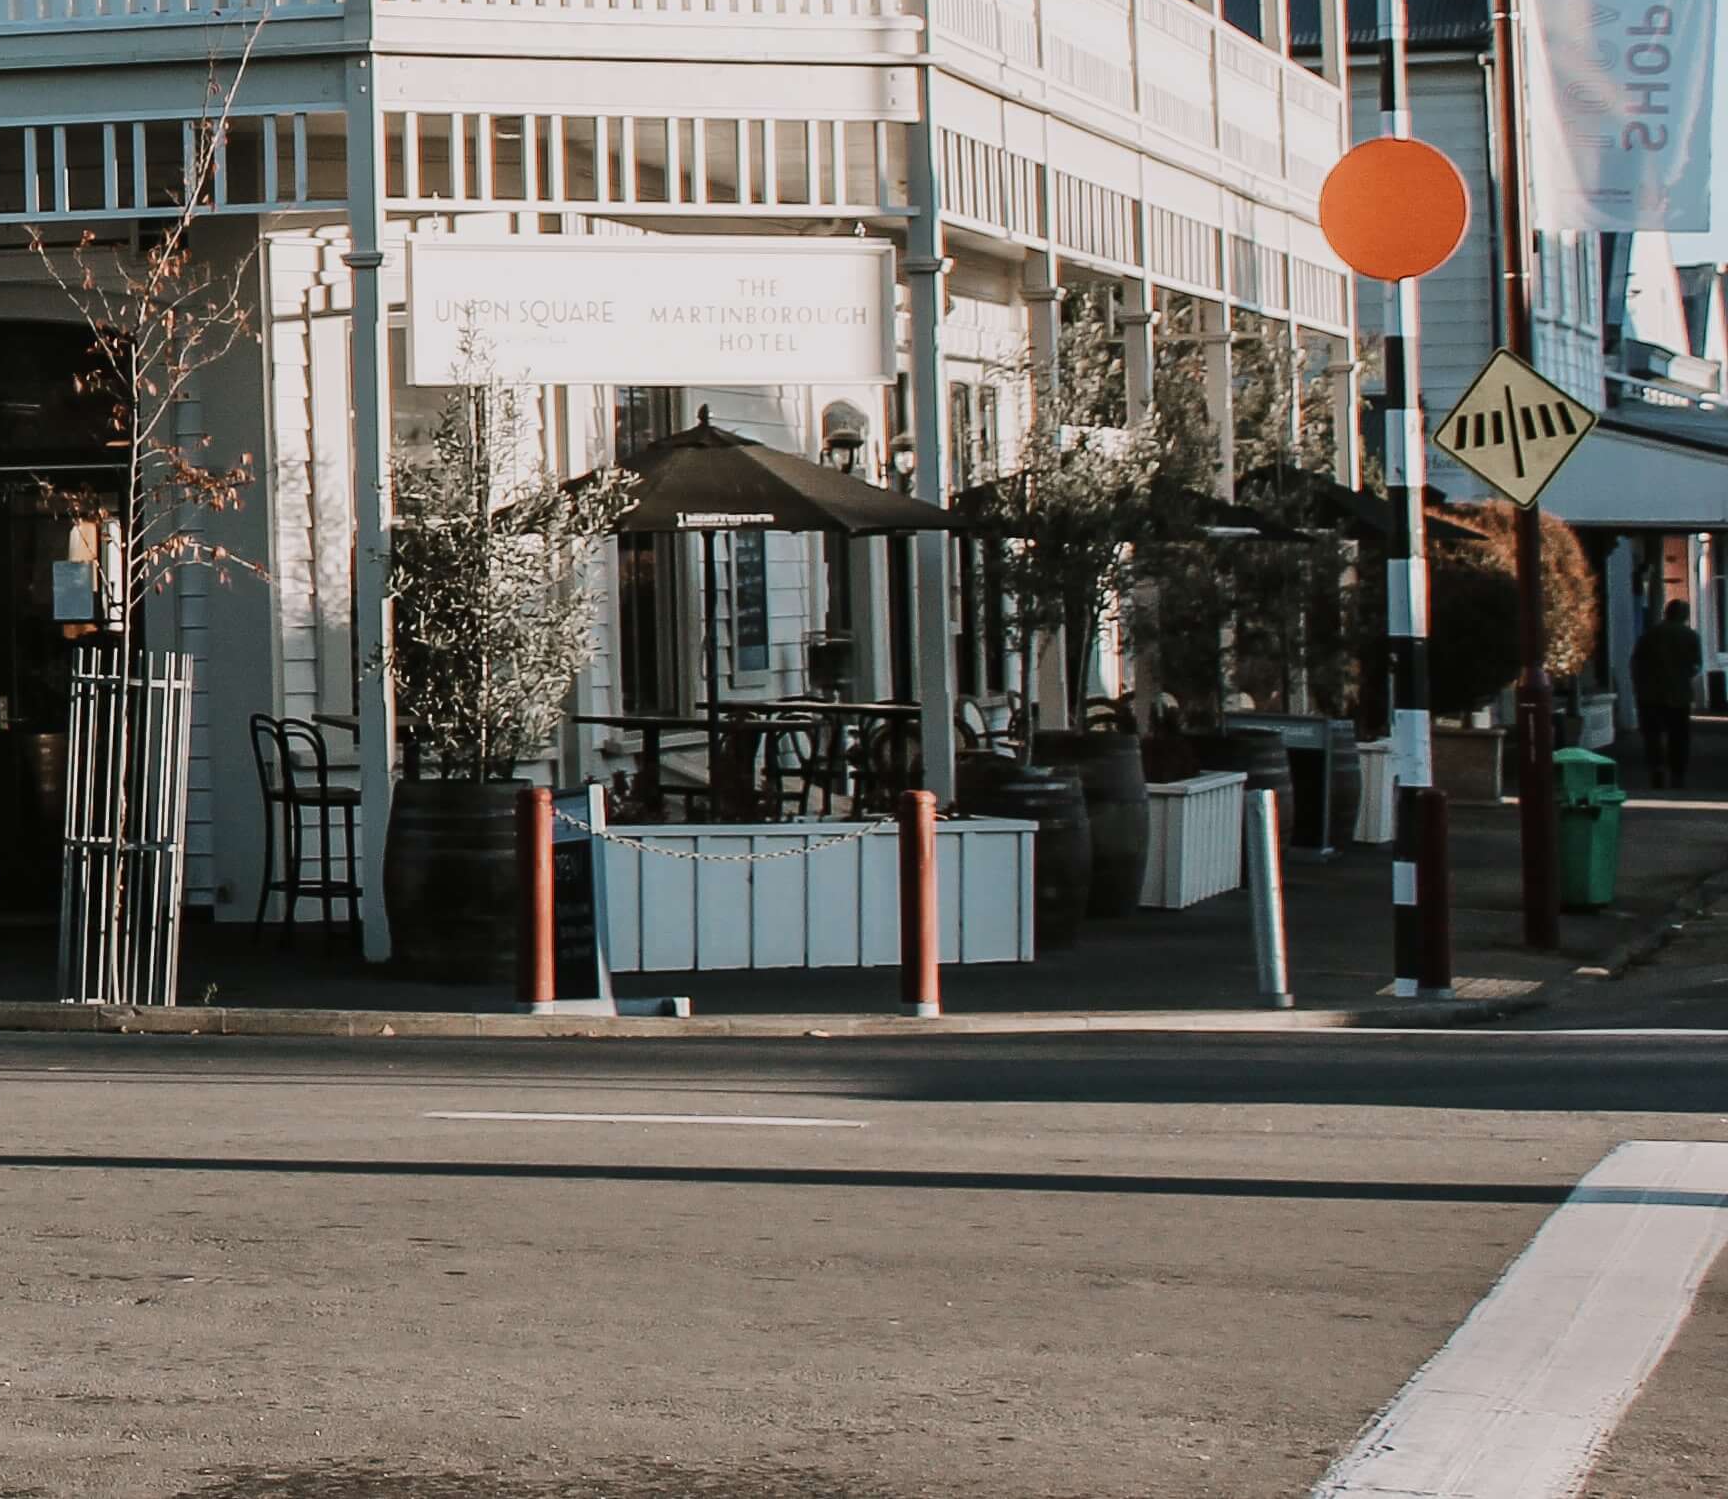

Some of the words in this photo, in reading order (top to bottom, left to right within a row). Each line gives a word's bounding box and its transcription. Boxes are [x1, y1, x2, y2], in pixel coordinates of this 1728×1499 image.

[737, 279, 778, 297] THE
[519, 299, 615, 329] SQUARE
[648, 305, 868, 325] MARTINBOROUGH
[719, 332, 799, 352] HOTEL
